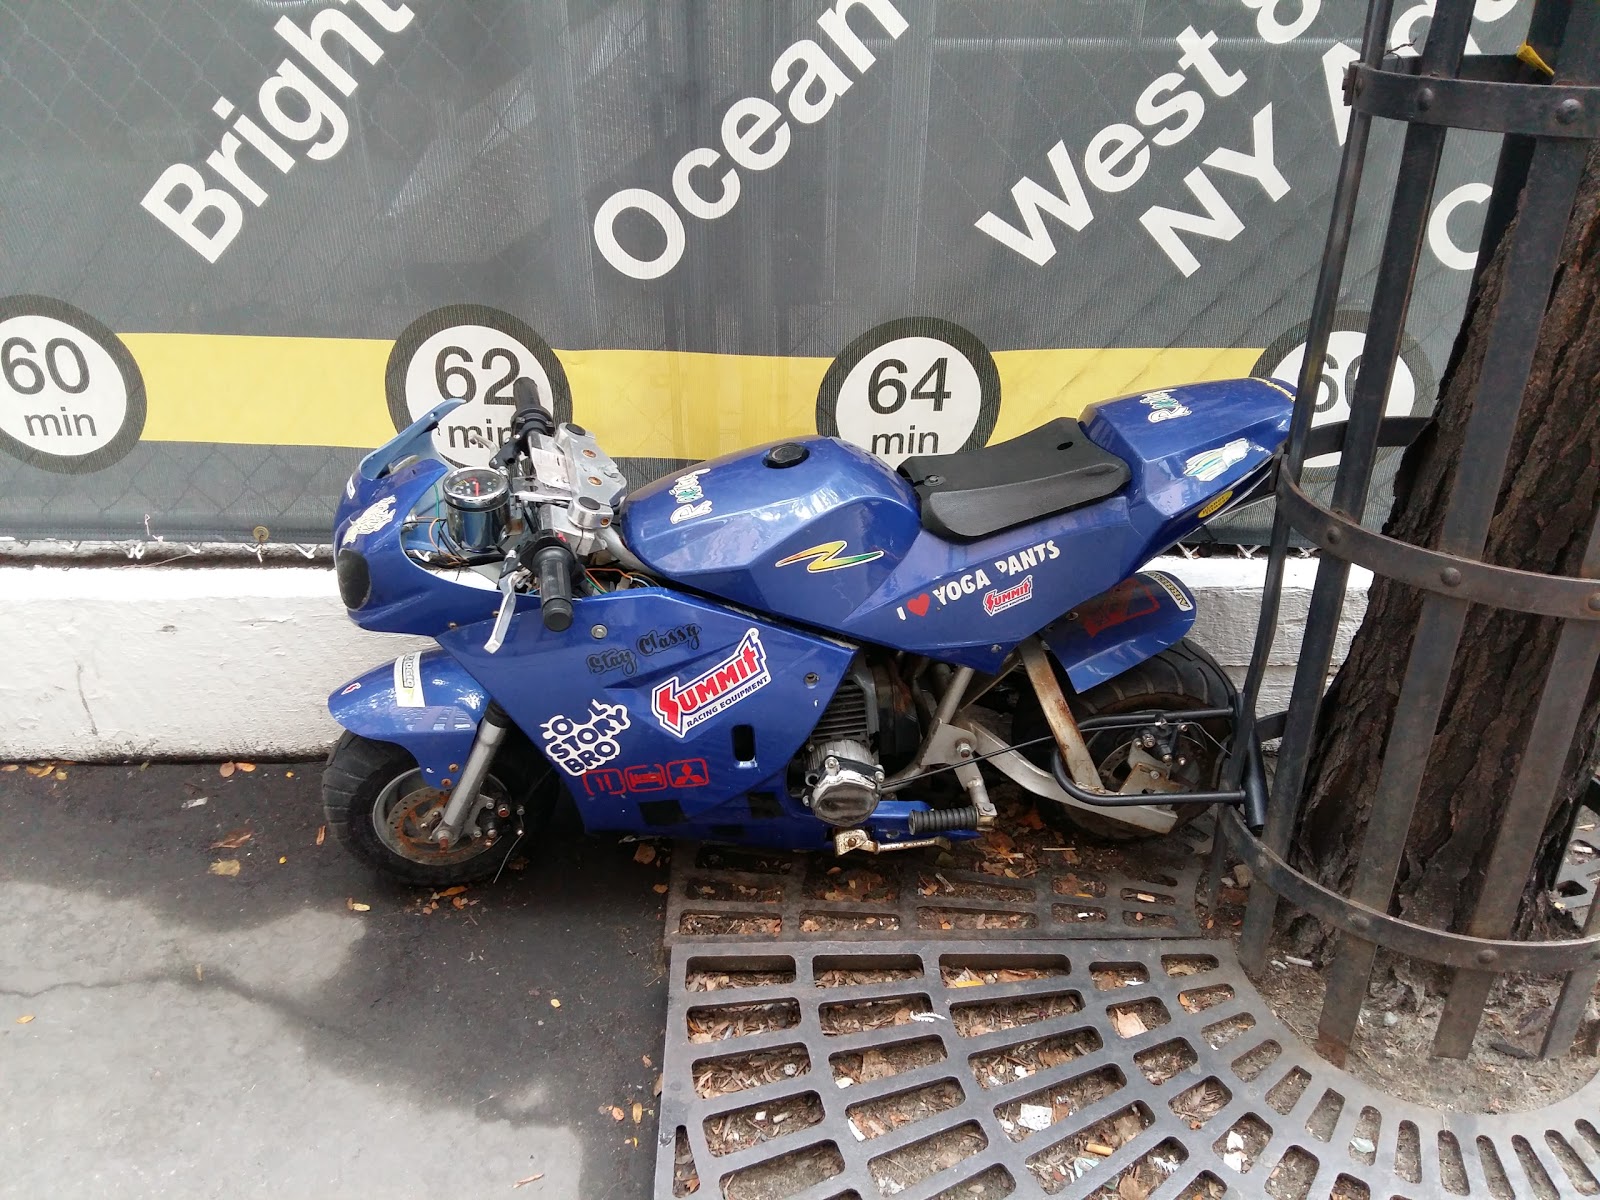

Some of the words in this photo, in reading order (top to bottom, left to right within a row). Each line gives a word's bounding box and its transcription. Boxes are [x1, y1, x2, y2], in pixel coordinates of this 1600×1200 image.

[594, 0, 909, 280] Ocean
[974, 25, 1247, 267] West
[1139, 103, 1291, 278] NY
[1, 337, 91, 396] 60
[435, 345, 521, 406] 62
[867, 357, 952, 415] 64
[24, 407, 97, 438] min
[871, 424, 940, 455] min
[932, 569, 991, 606] YOGA
[994, 540, 1061, 576] PANTS
[587, 649, 637, 676] Stay
[638, 623, 702, 655] Classy
[686, 705, 719, 728] RACING
[719, 676, 768, 709] EQUIPMENT
[549, 707, 627, 760] STORY
[563, 741, 616, 773] BRO
